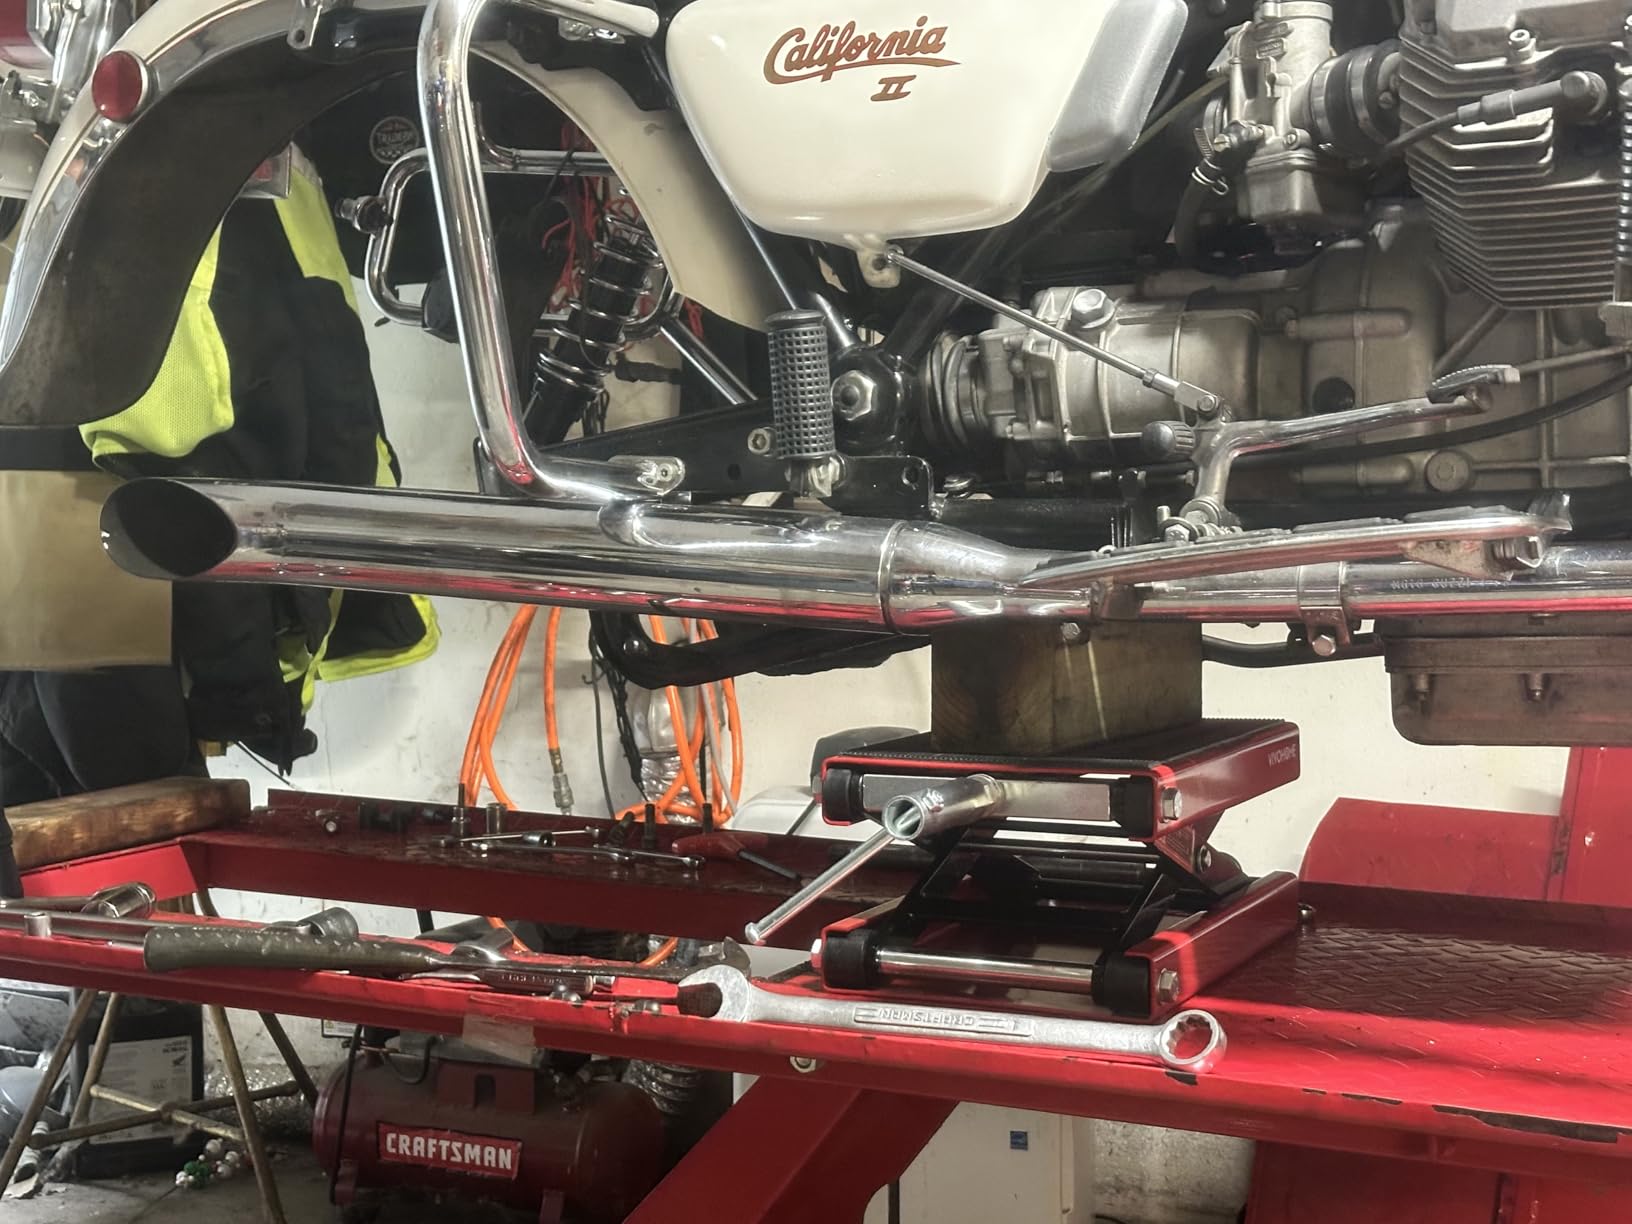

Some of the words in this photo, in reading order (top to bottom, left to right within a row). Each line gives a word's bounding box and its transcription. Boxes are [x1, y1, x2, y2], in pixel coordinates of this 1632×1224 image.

[763, 15, 961, 85] California
[870, 74, 917, 102] II
[879, 1007, 976, 1027] CRAFTSMAN
[386, 1132, 512, 1170] CRAFTSMAN
